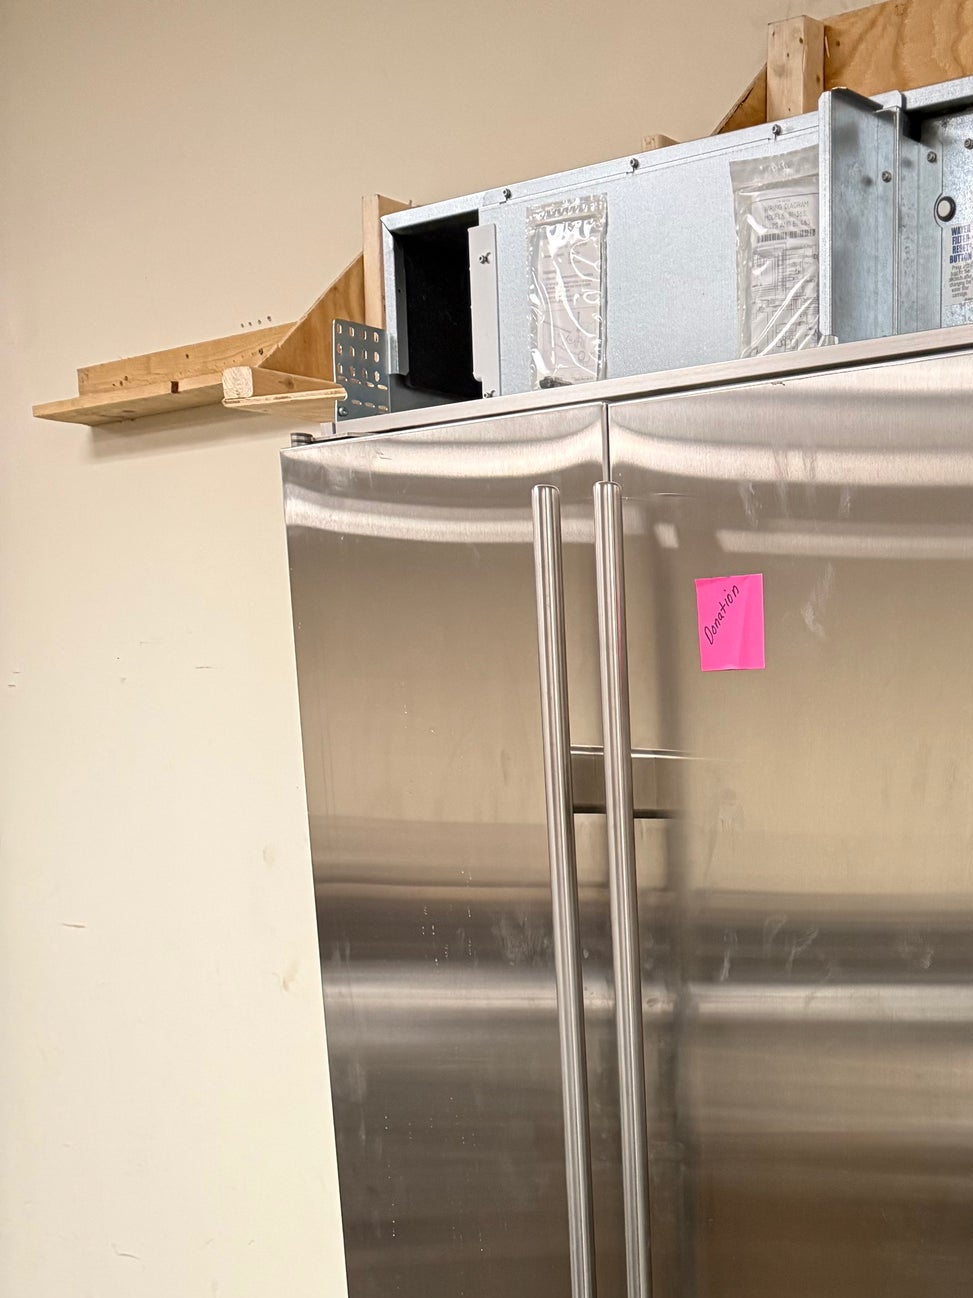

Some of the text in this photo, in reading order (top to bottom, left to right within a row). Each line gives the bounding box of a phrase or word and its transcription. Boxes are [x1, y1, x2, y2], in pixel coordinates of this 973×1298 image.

[951, 224, 970, 235] WATER
[952, 235, 970, 245] FILTER
[952, 244, 969, 254] RESET
[950, 254, 972, 264] BUTTON
[704, 584, 740, 646] Donation
